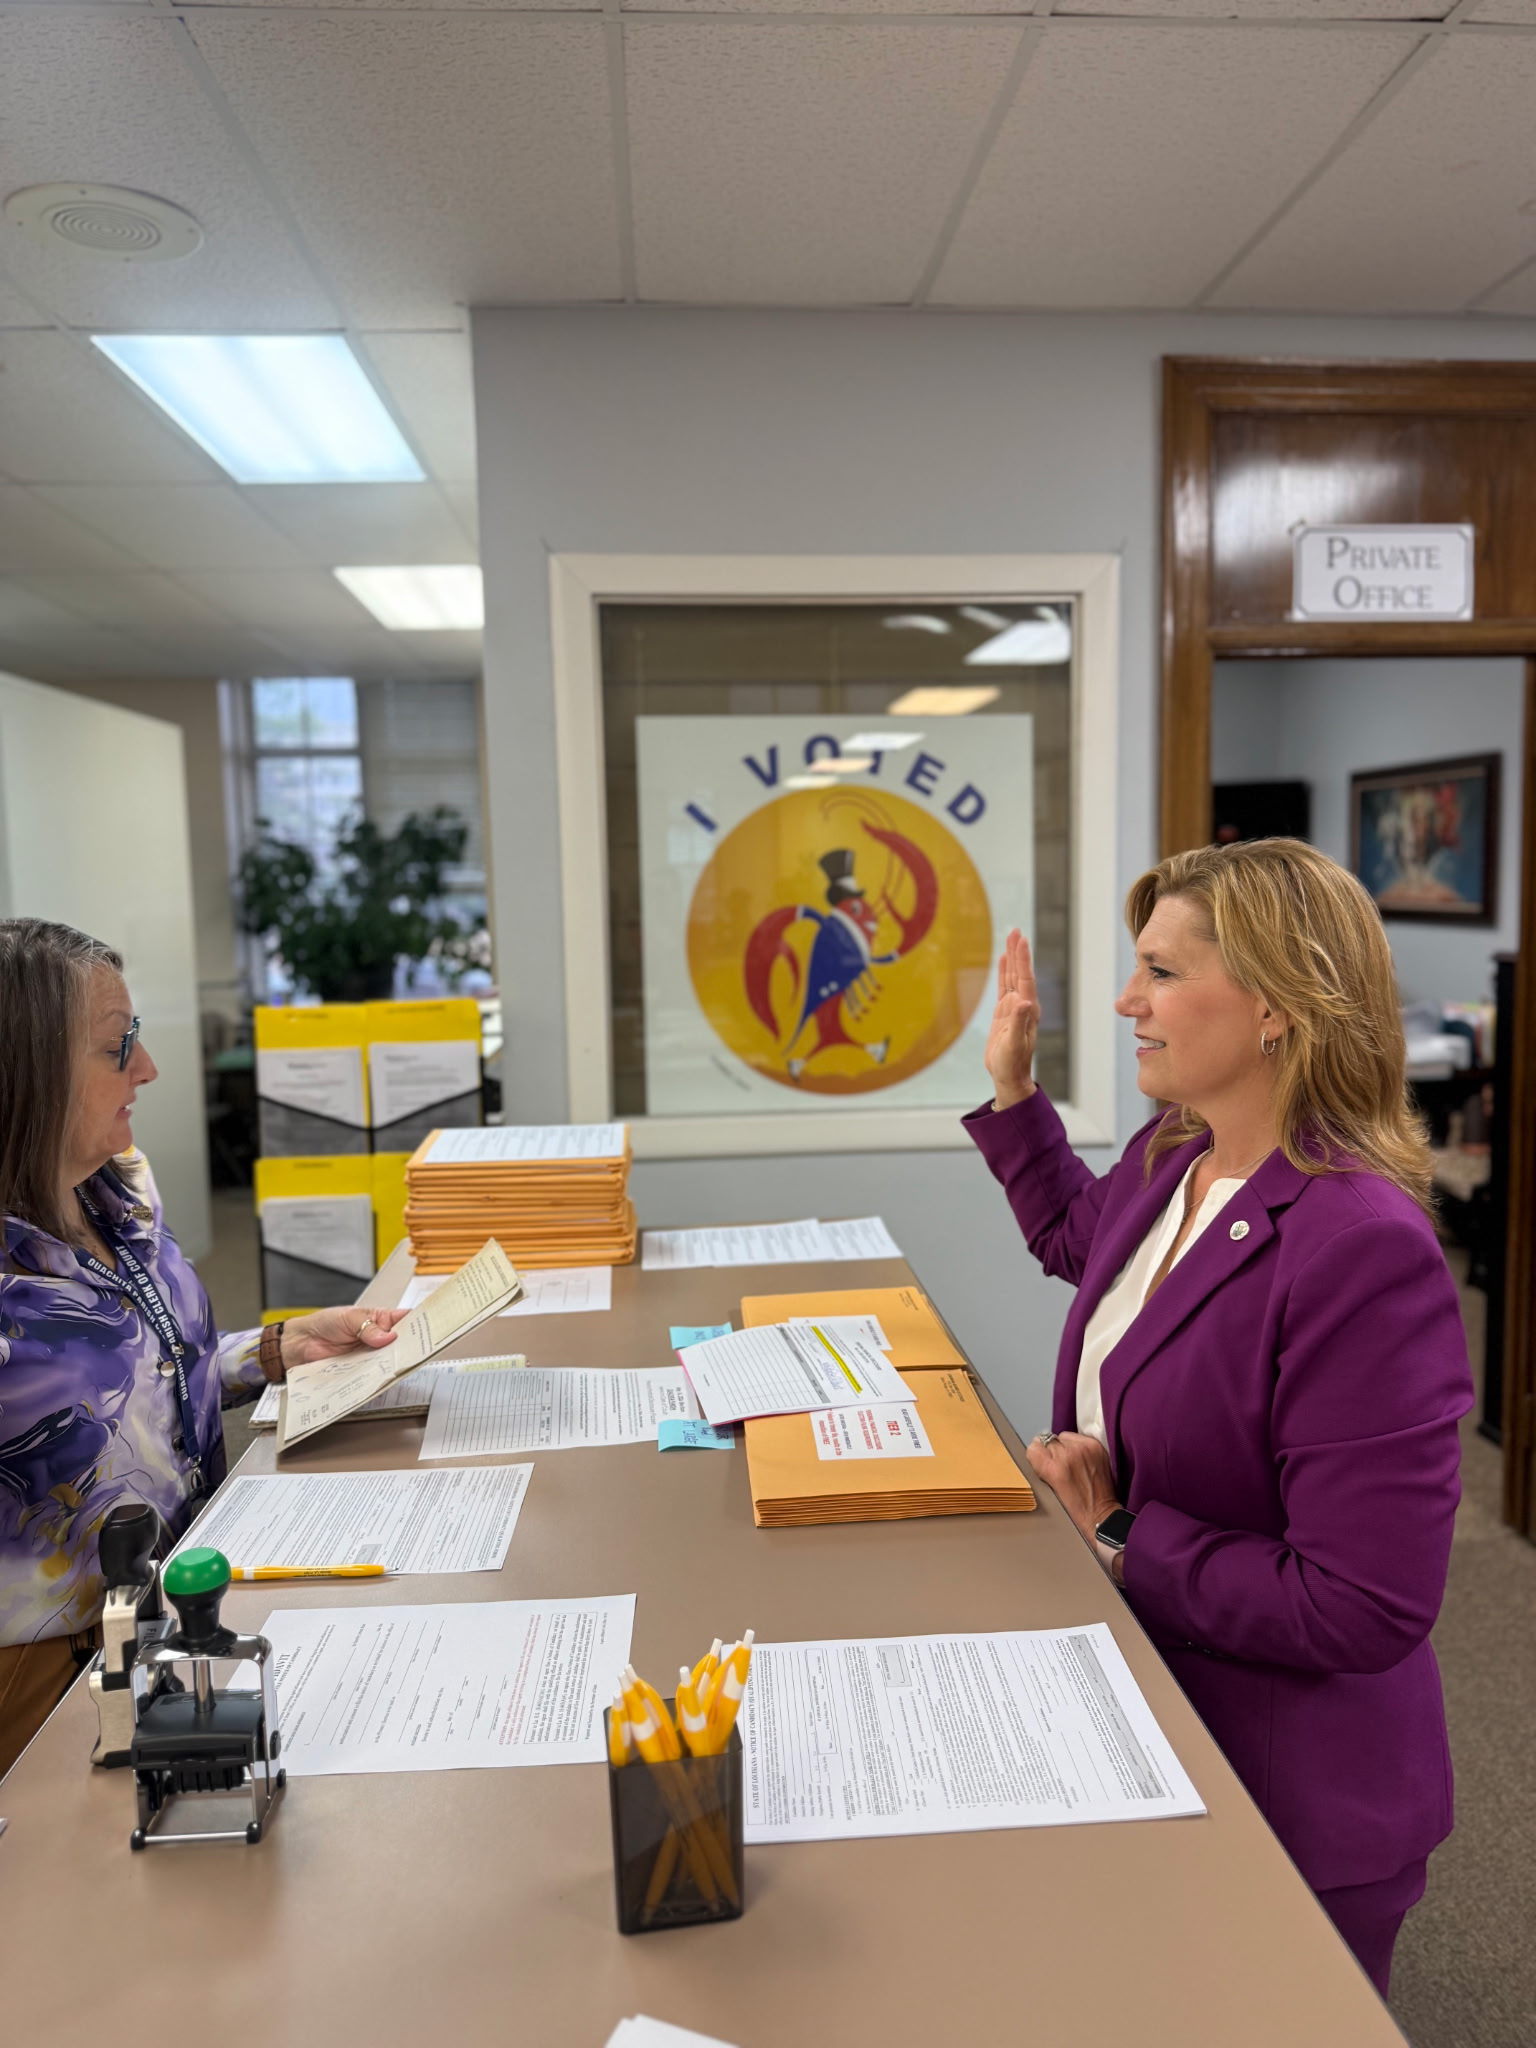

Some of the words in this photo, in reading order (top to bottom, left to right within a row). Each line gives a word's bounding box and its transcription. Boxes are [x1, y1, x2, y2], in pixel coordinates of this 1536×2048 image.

[1326, 536, 1442, 570] PRIVATE
[1333, 575, 1433, 610] OFFICE
[684, 801, 718, 833] I
[115, 1245, 141, 1273] COURT
[87, 1258, 132, 1292] OUACHITA
[131, 1289, 155, 1324] PARISH
[134, 1272, 148, 1285] OF
[145, 1285, 163, 1316] CLERK
[886, 1420, 899, 1431] TIER
[274, 1654, 290, 1680] IDAVIT
[748, 1705, 756, 1729] CANDIDACY
[751, 1757, 759, 1784] LOUISIANA
[752, 1784, 759, 1792] OF
